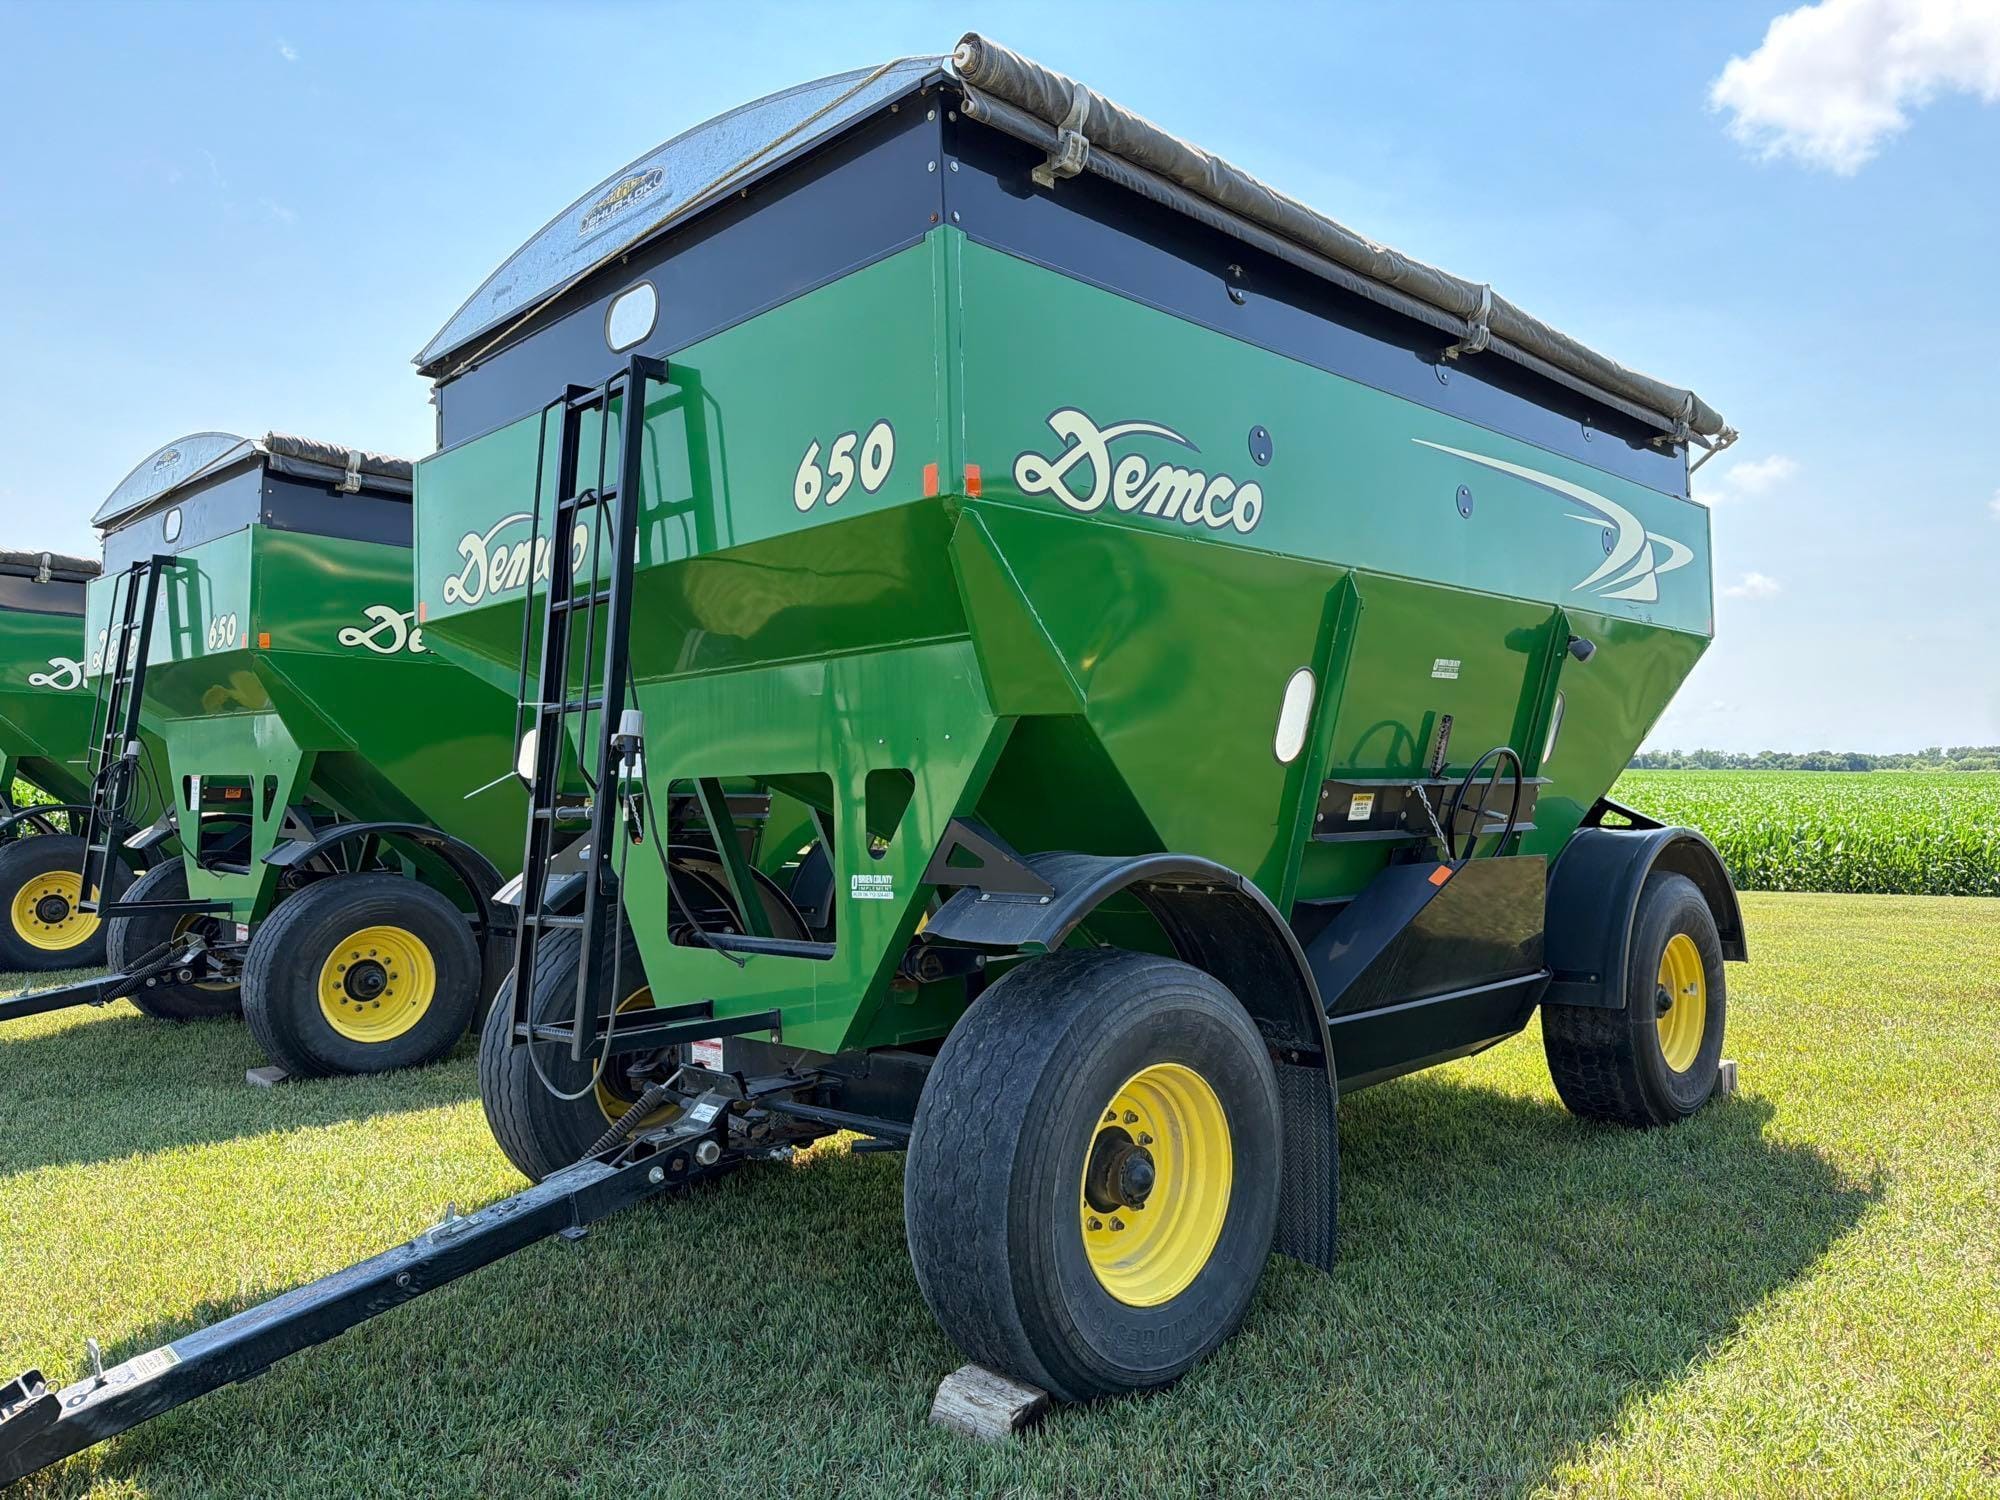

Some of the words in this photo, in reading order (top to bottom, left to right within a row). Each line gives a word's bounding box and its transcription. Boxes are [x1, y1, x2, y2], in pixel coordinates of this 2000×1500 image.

[793, 418, 896, 513] 650
[1013, 406, 1263, 534] Demco
[208, 612, 237, 650] 650
